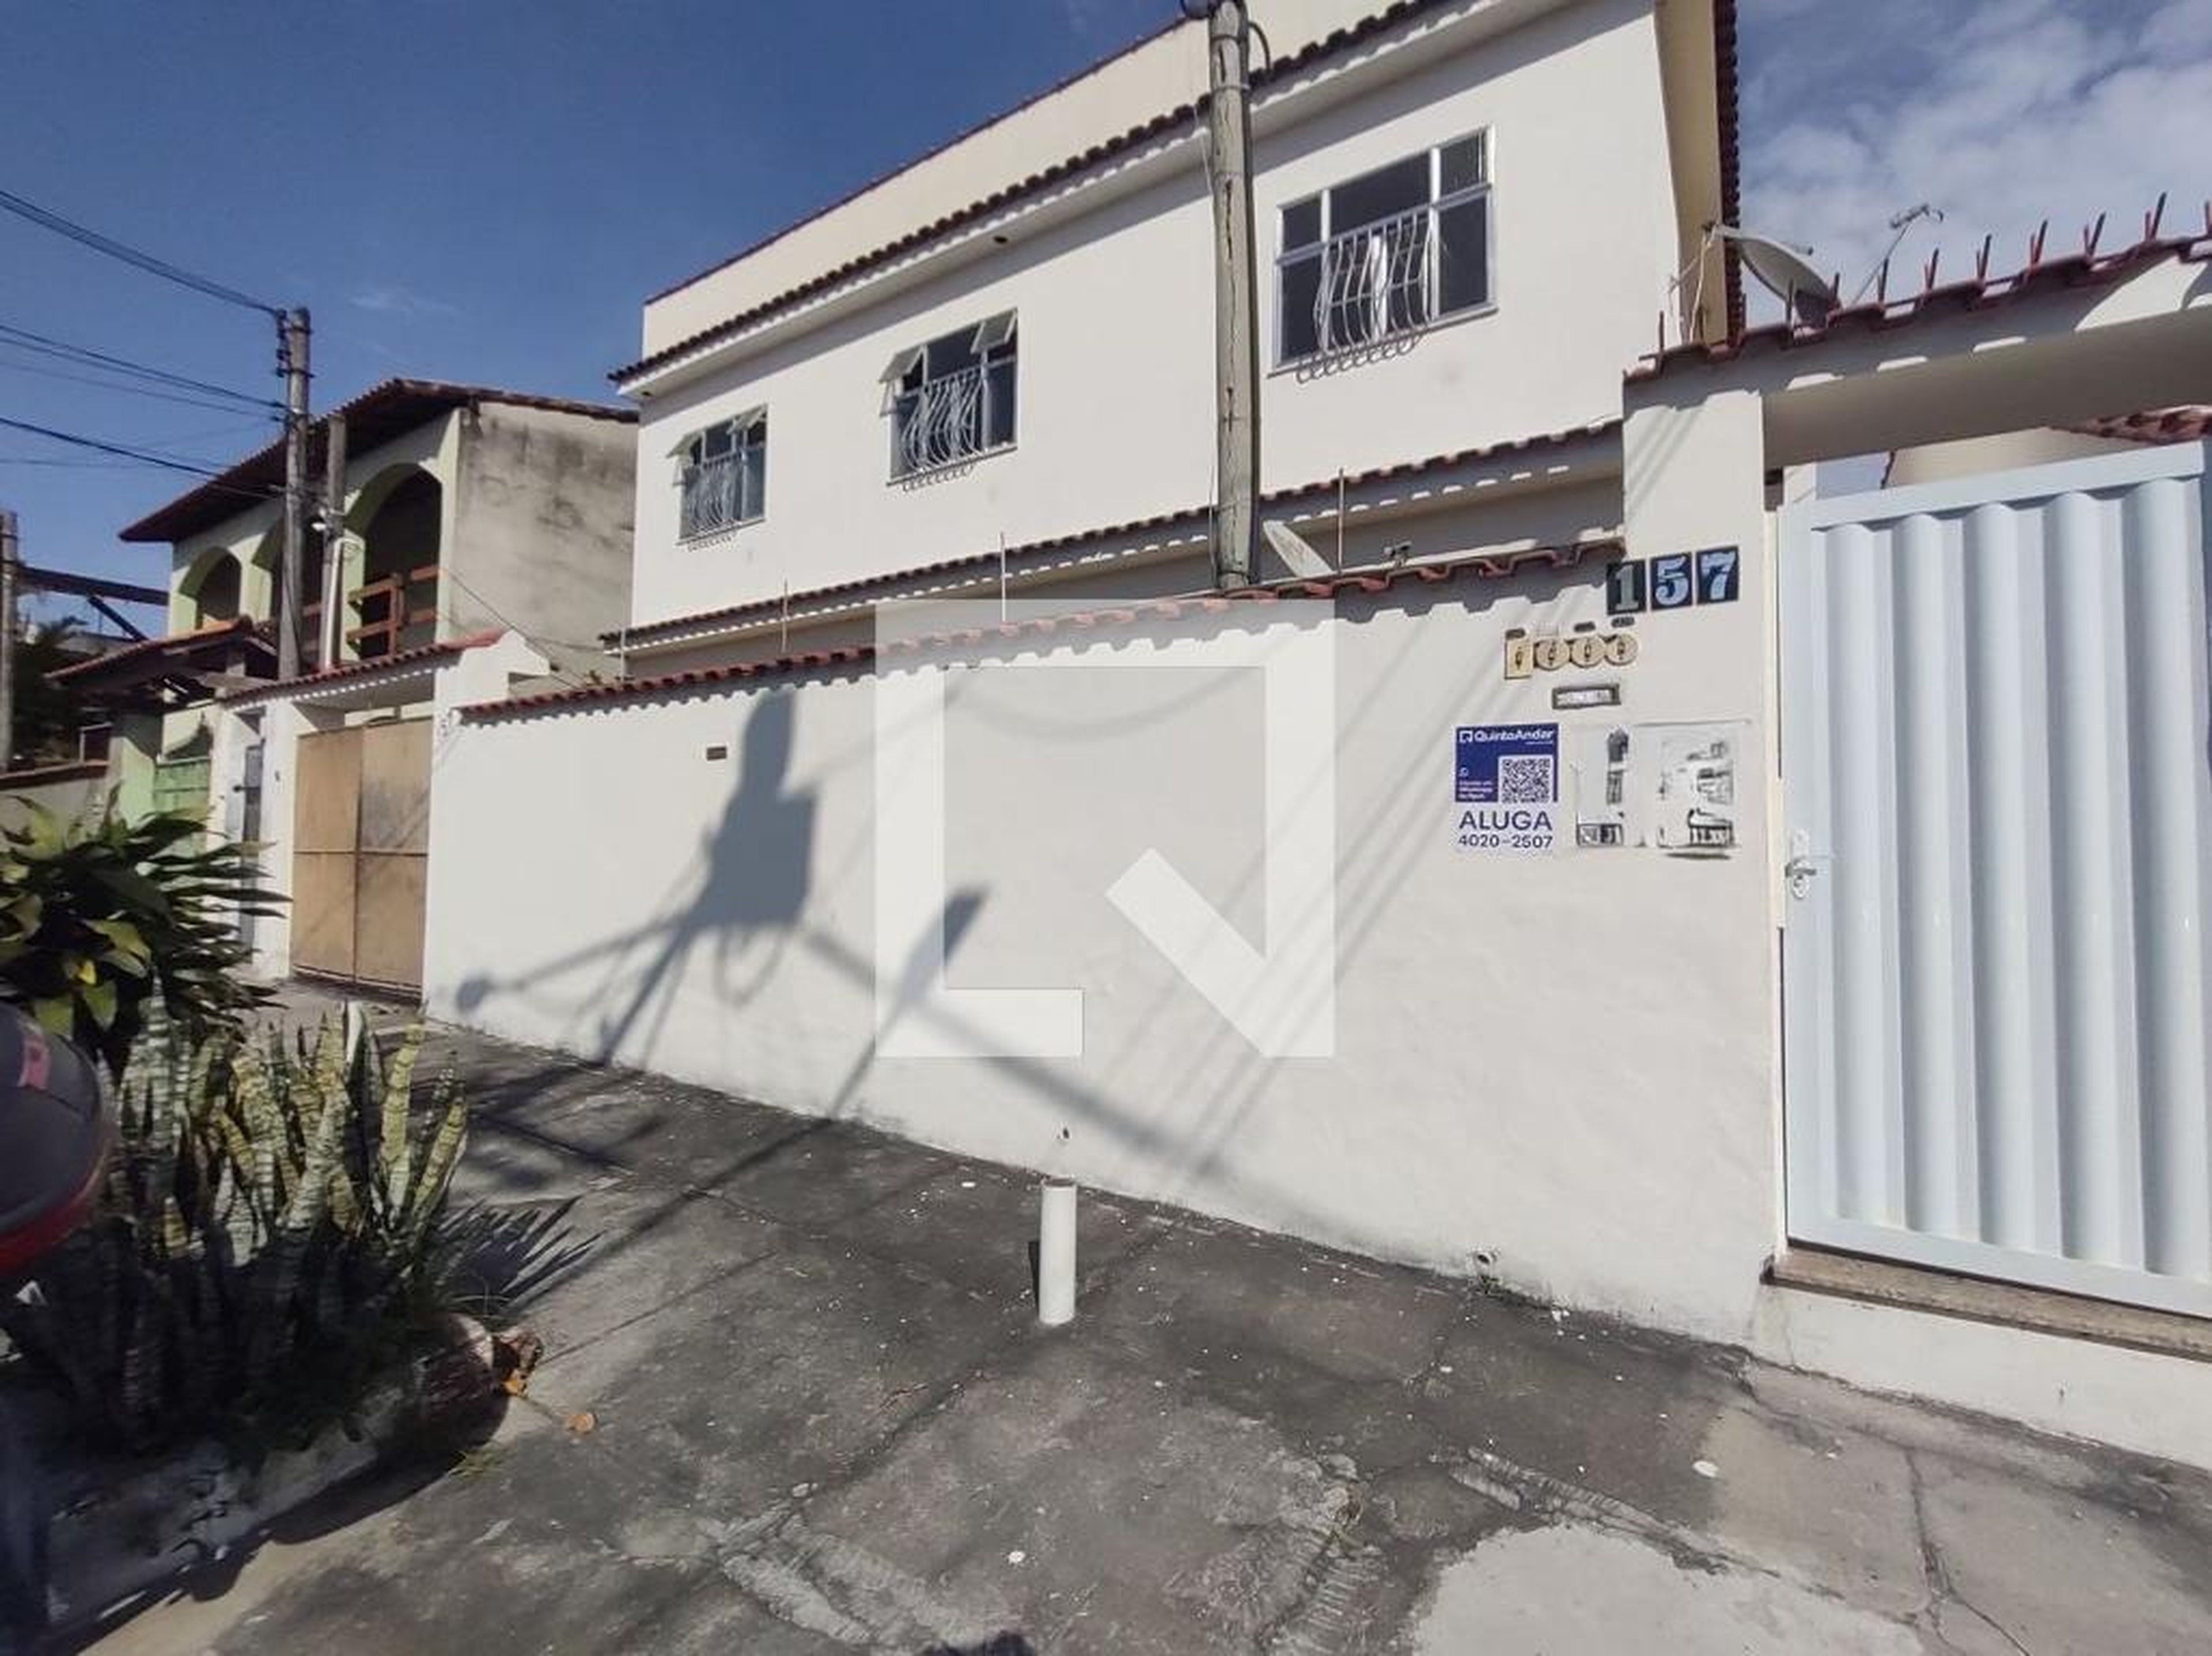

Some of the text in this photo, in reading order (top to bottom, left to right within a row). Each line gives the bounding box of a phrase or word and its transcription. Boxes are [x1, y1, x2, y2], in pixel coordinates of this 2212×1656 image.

[1613, 550, 1737, 611] 157
[1459, 810, 1552, 831] ALUGA
[1459, 834, 1553, 848] 4020-2507
